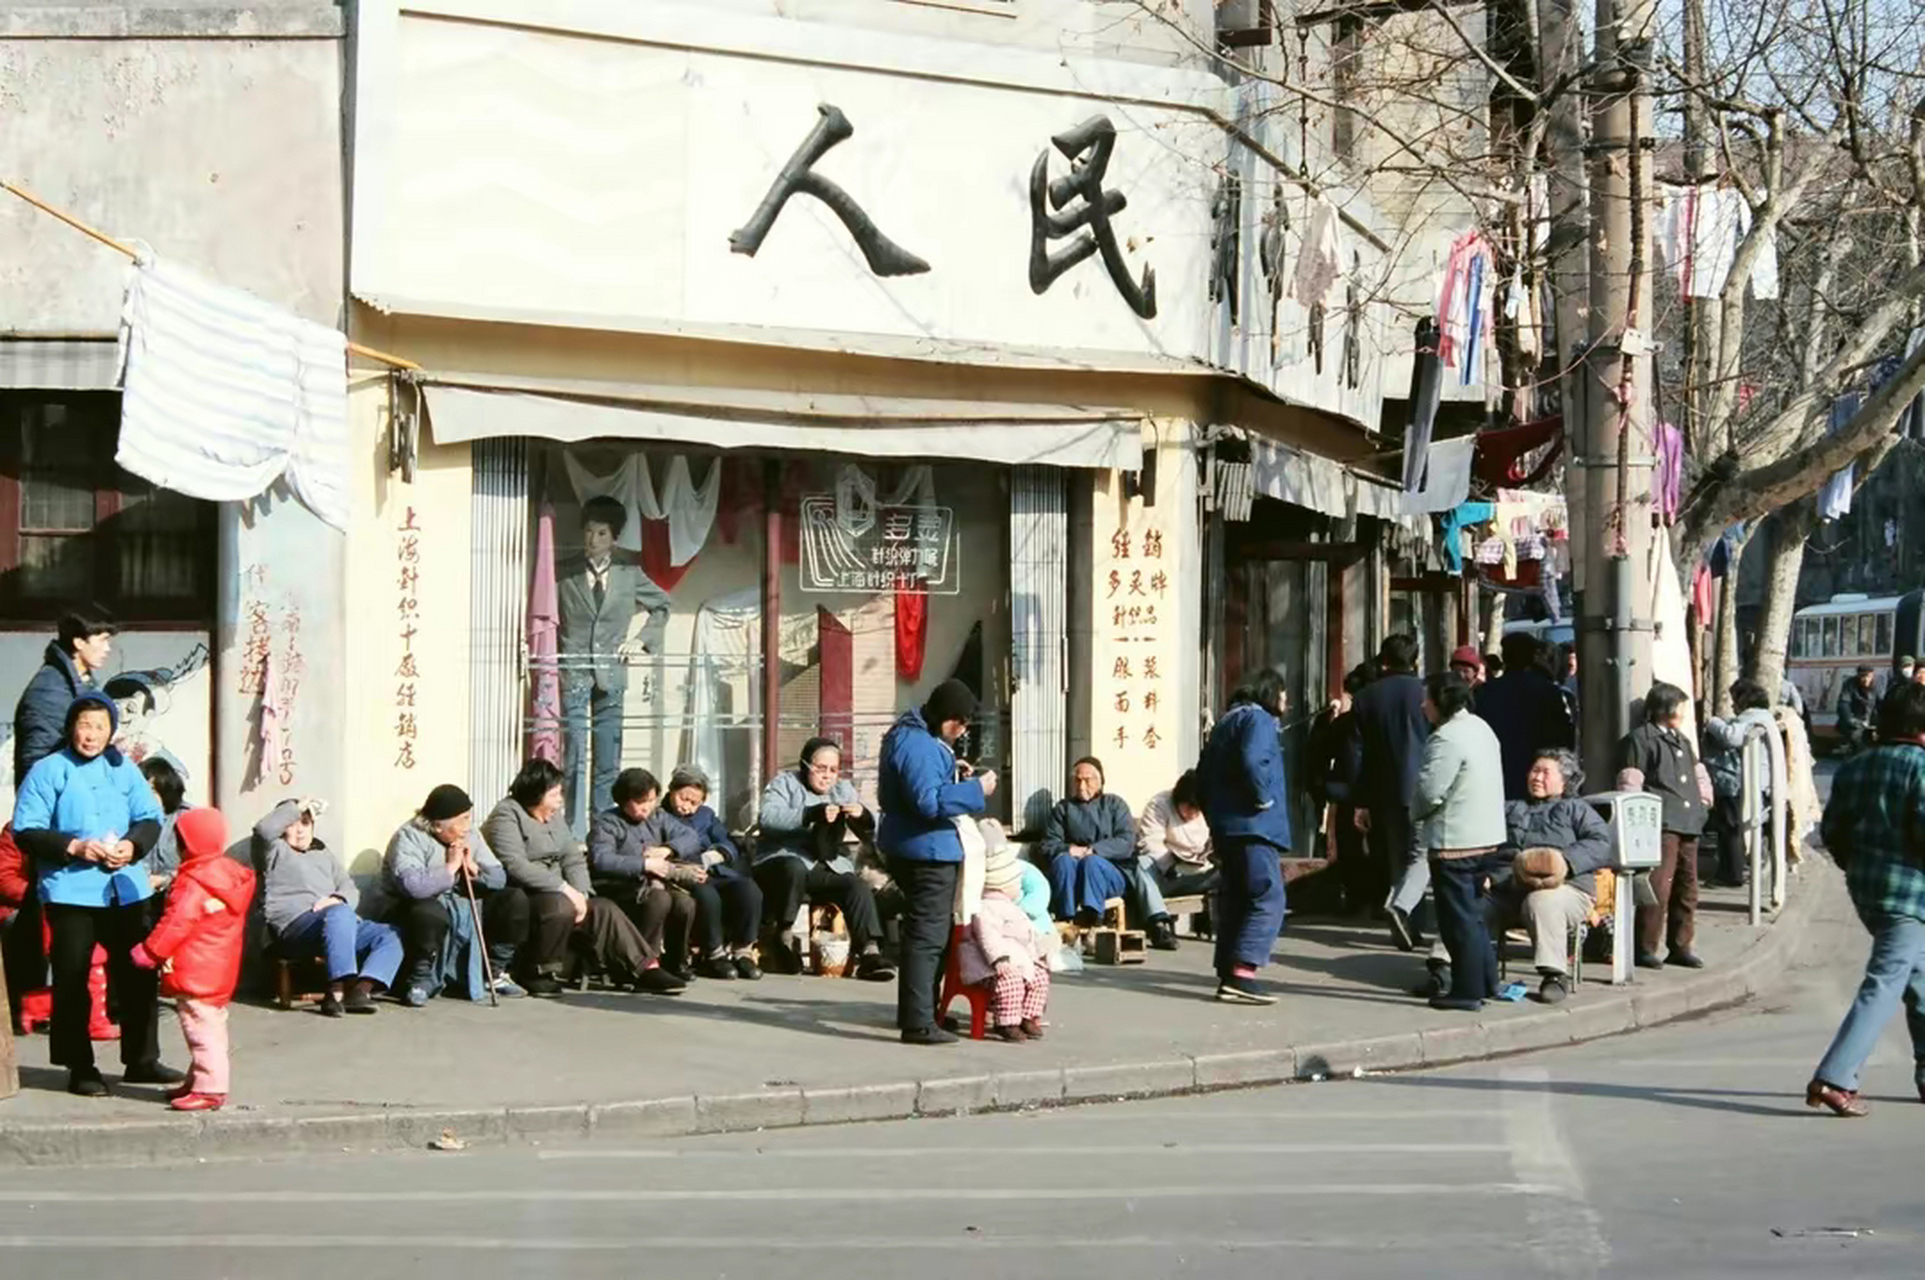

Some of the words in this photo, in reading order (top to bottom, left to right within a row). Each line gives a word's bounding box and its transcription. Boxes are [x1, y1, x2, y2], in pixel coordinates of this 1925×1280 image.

[728, 101, 1156, 319] 人民
[1114, 688, 1161, 714] 面料
[1113, 725, 1162, 750] 手套
